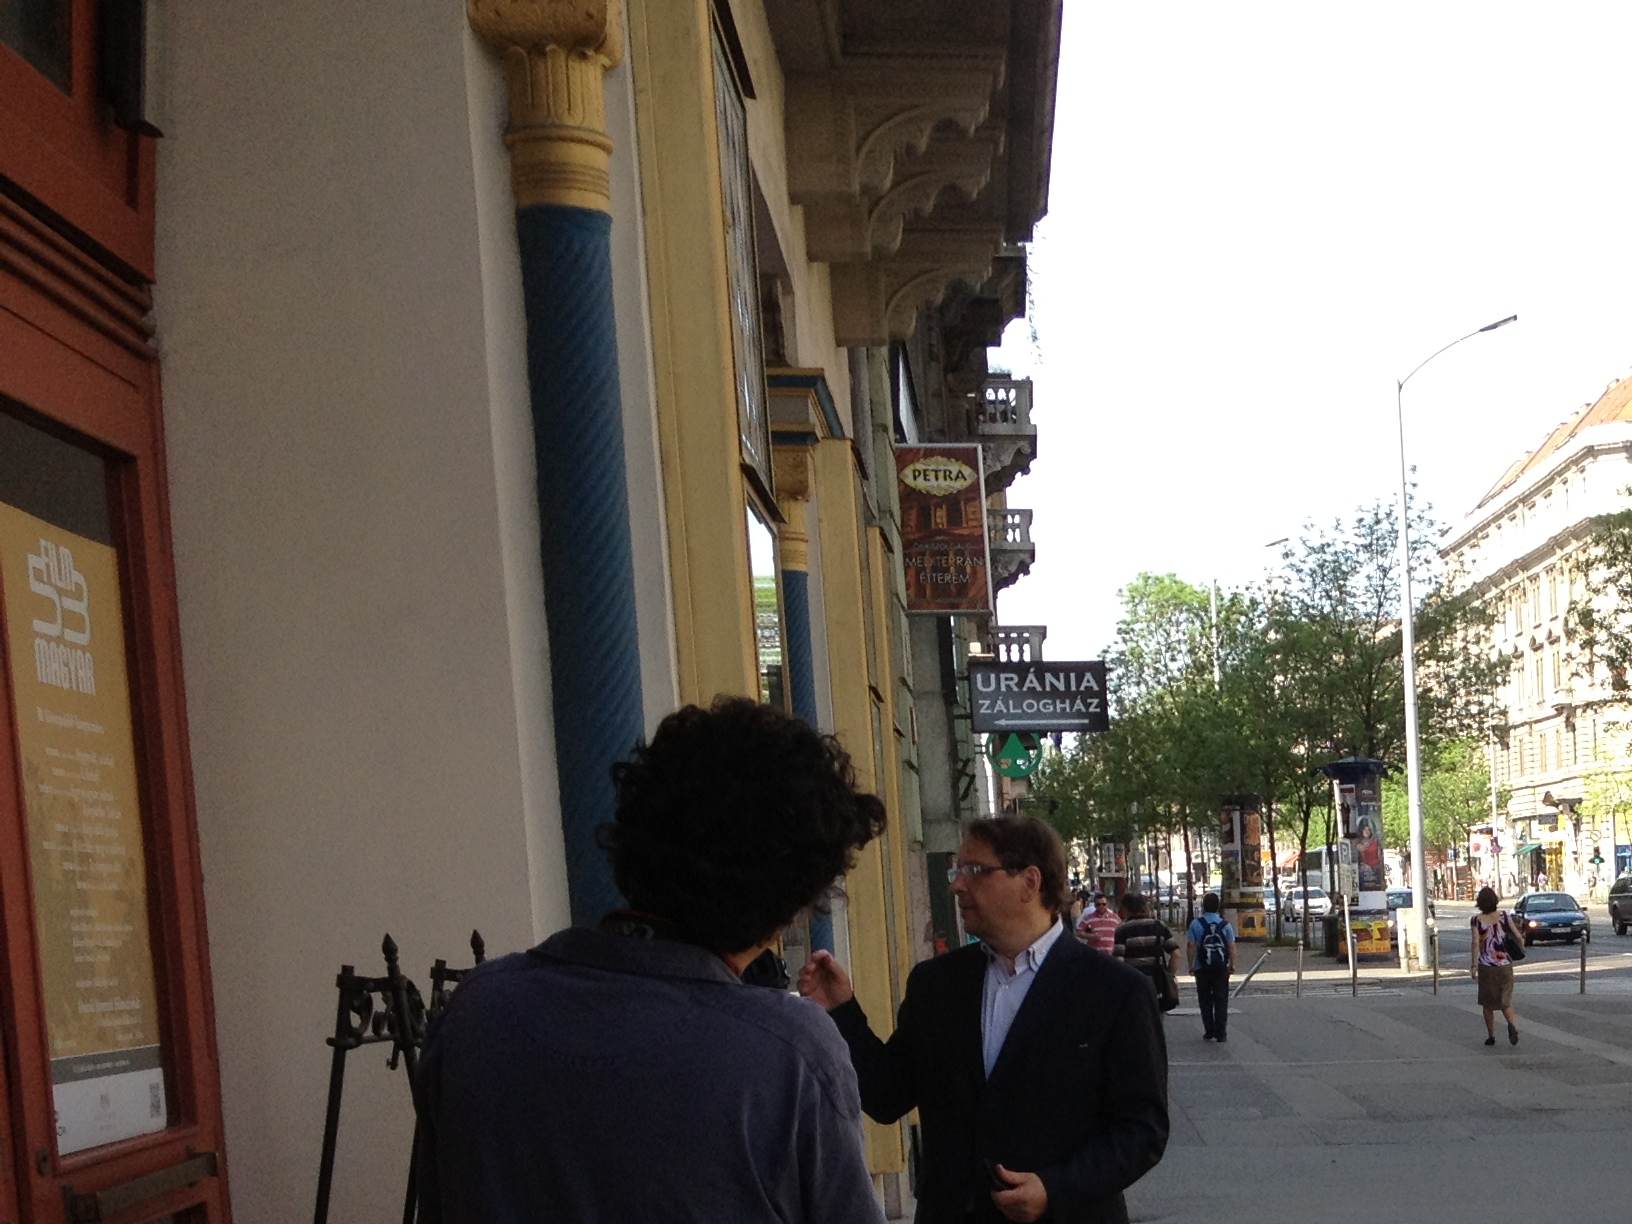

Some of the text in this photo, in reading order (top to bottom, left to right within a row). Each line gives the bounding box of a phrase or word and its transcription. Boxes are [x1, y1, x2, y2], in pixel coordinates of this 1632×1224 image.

[912, 468, 967, 482] PETRA
[39, 538, 76, 593] FILM
[34, 637, 96, 697] MAGYAR
[976, 667, 1100, 692] URÁNIA
[978, 695, 1101, 713] ZÁLOGHÁZ
